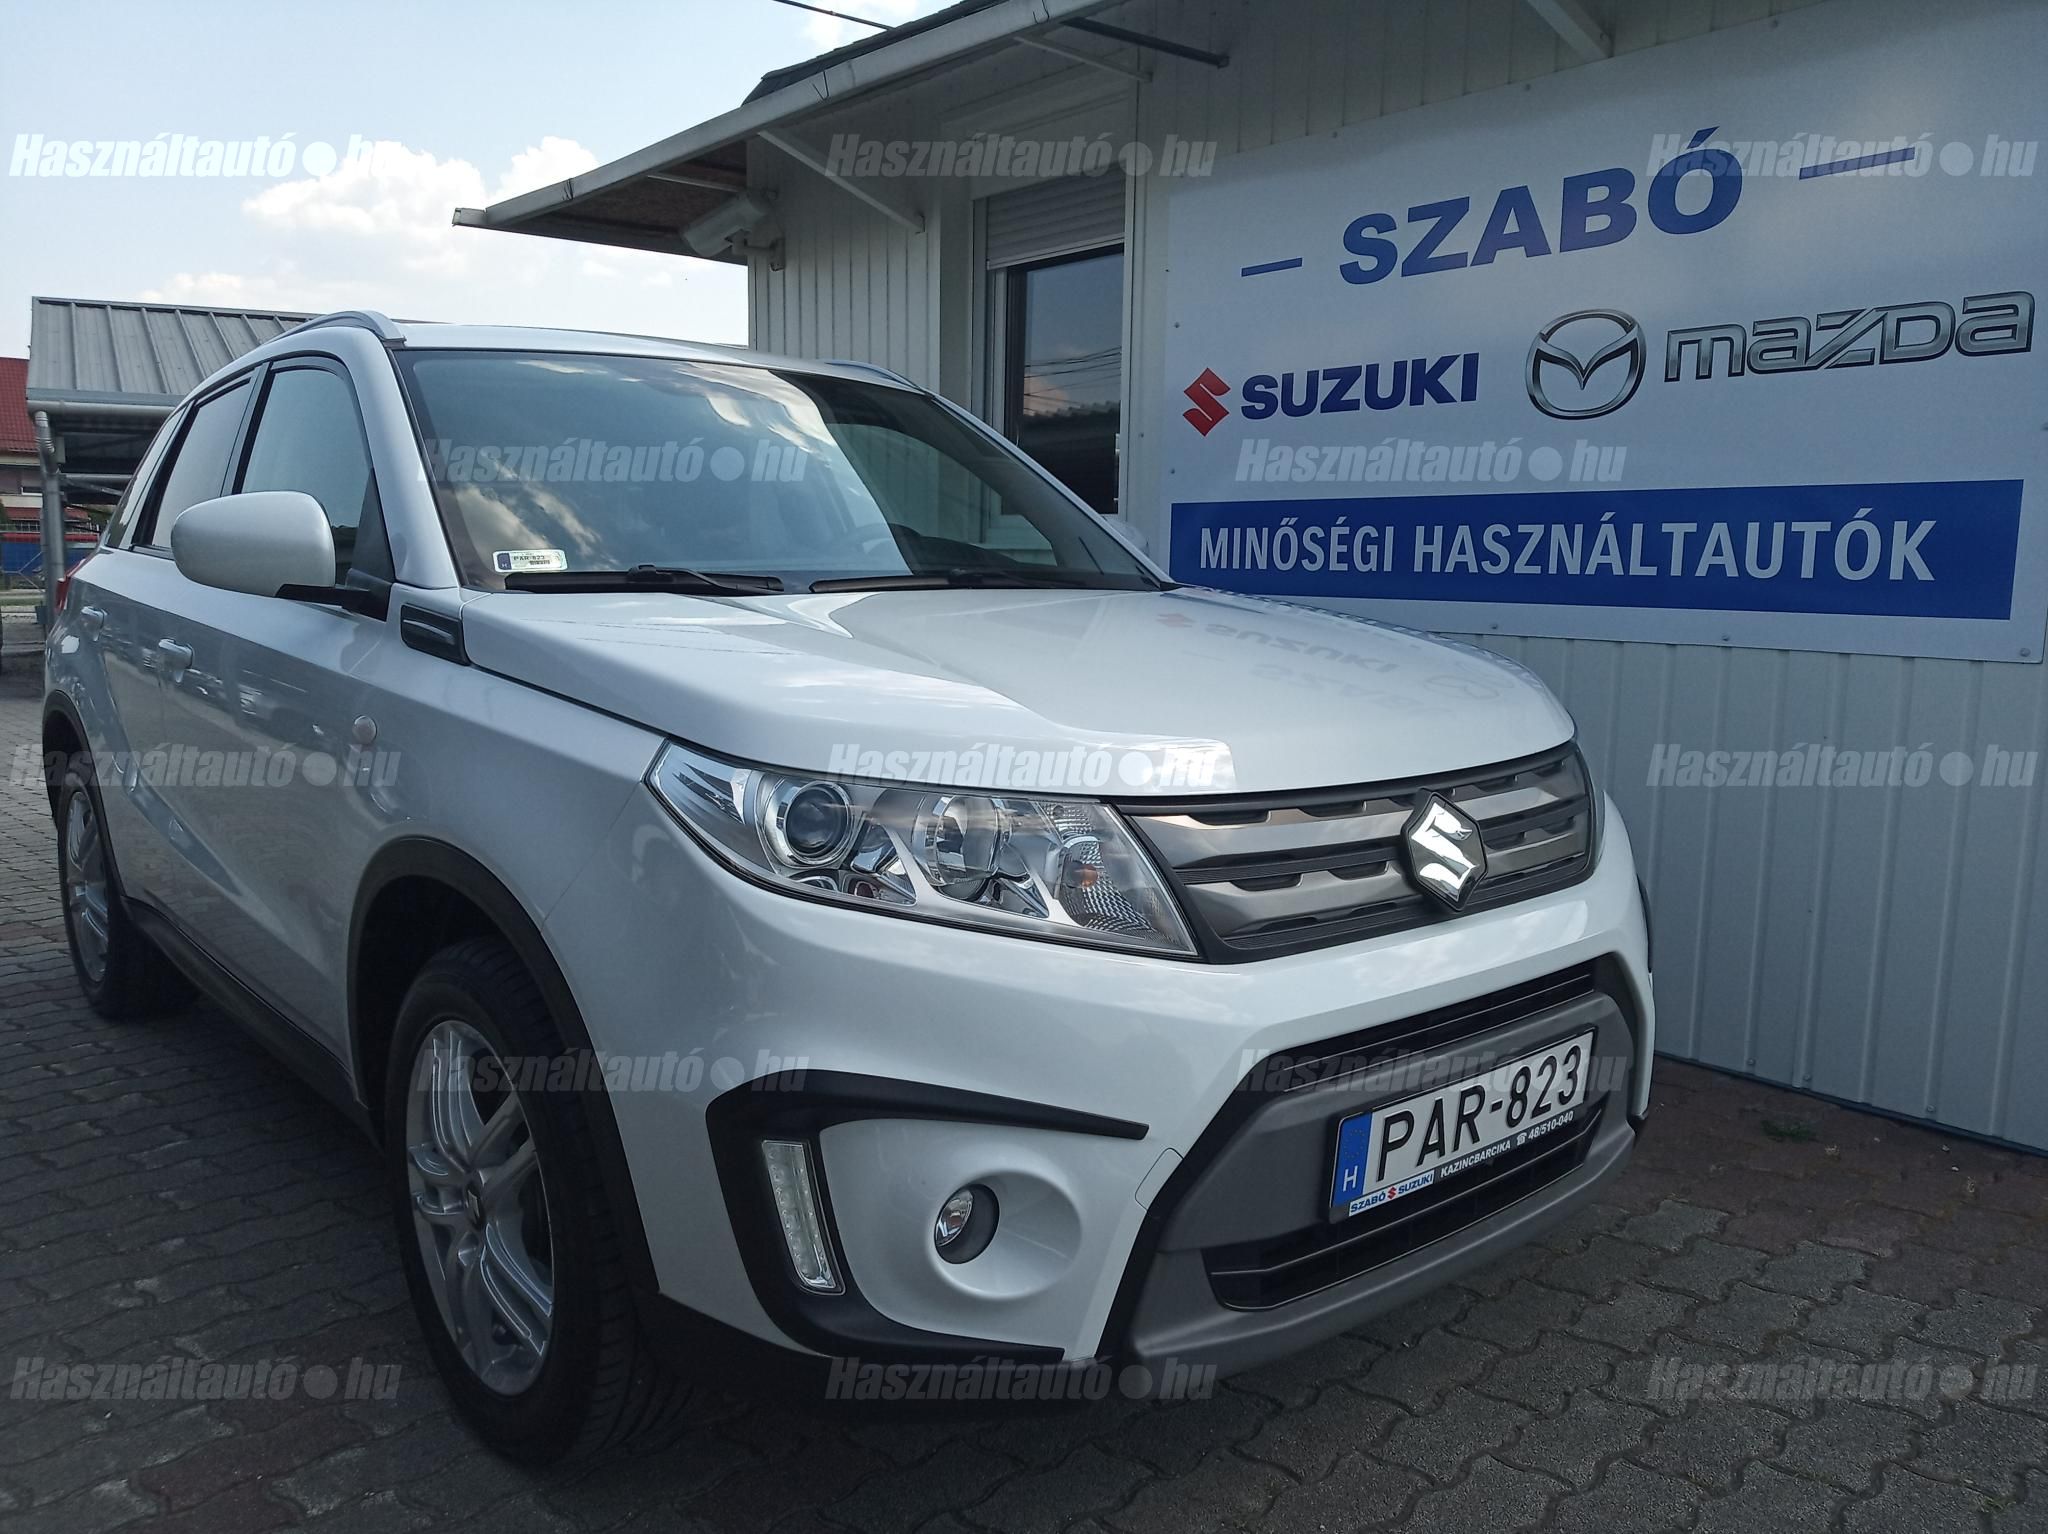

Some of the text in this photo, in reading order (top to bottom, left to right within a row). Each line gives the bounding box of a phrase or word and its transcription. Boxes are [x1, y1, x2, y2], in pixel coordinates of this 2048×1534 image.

[1339, 125, 1744, 286] SZABÓ
[1241, 352, 1479, 420] SUZUKI
[1200, 507, 1937, 582] MINŐSÉGI HASZNÁLTAUTÓK
[1375, 1044, 1582, 1182] PAR-823
[1342, 1166, 1358, 1192] H
[1350, 1189, 1386, 1213] SZABÓ
[1398, 1173, 1433, 1194] SUZUKI
[1440, 1140, 1511, 1178] KAZINCBARCIKA
